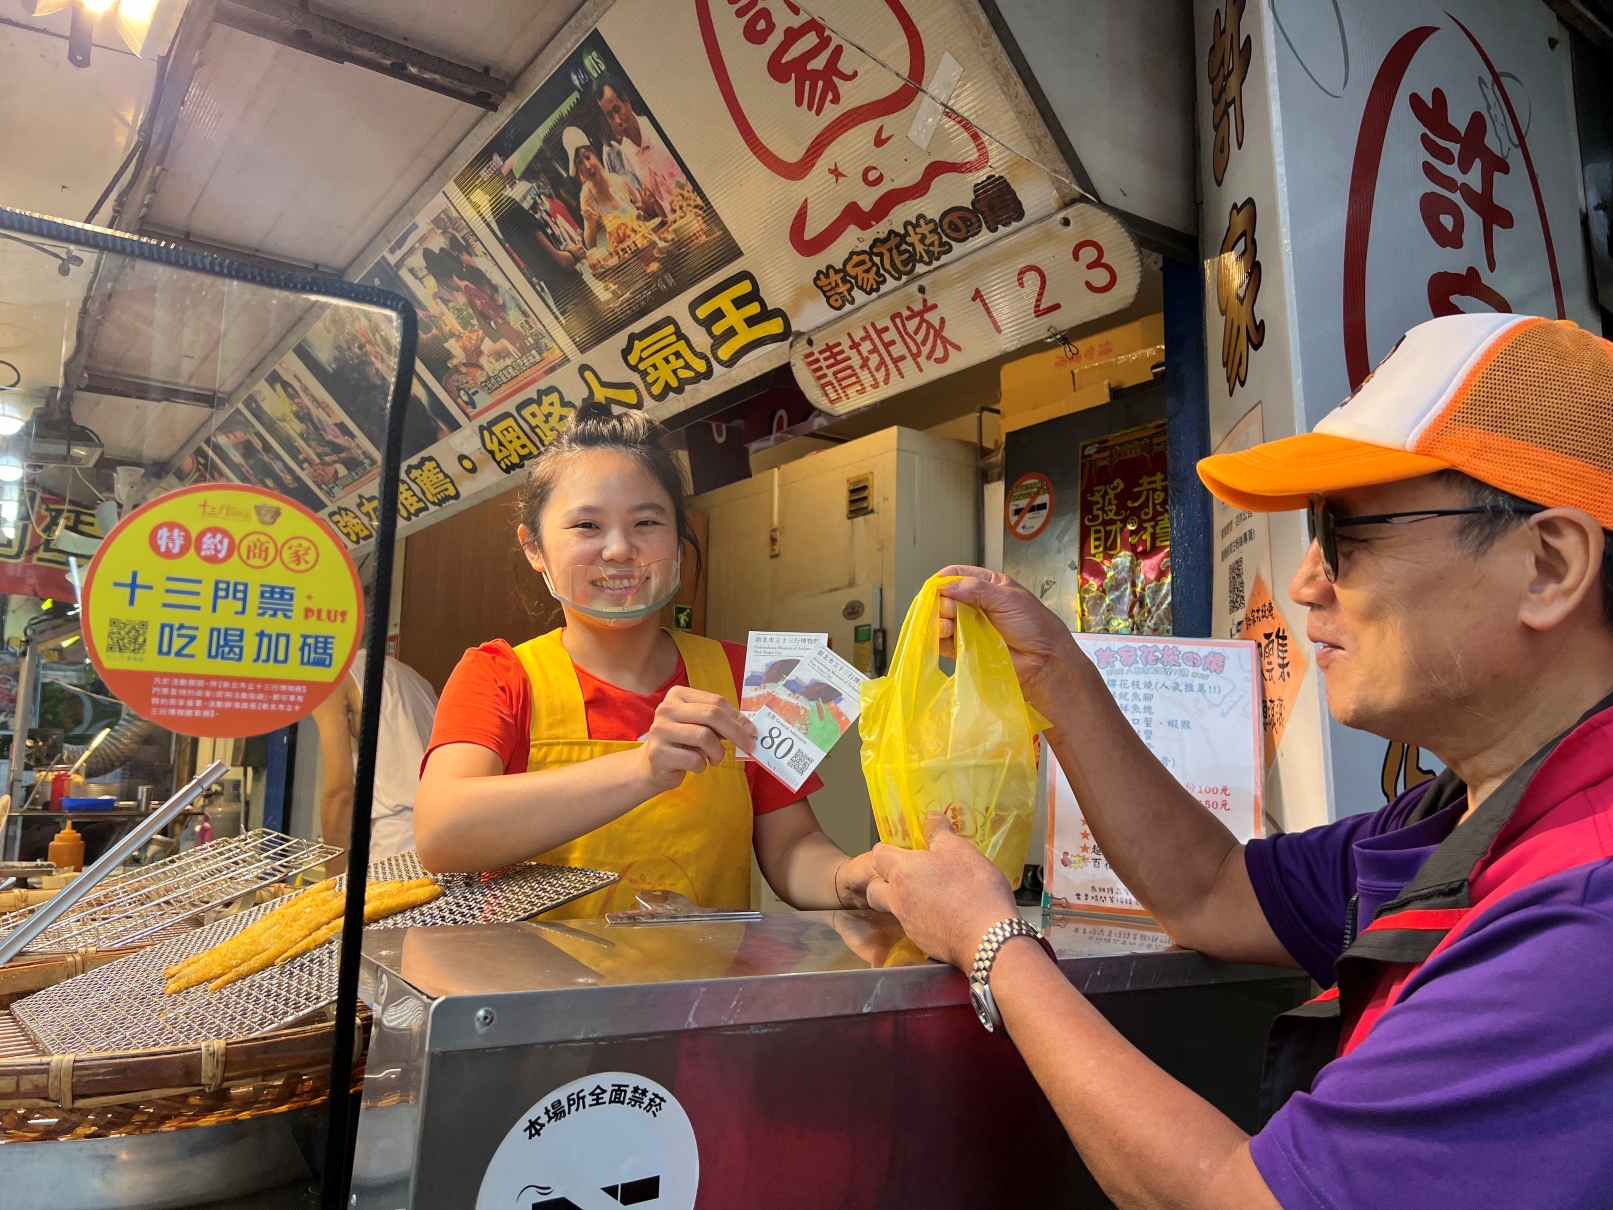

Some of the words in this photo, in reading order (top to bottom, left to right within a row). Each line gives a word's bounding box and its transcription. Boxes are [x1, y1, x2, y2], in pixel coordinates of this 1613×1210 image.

[804, 293, 962, 406] 請排隊
[971, 286, 1003, 335] 1
[1017, 264, 1062, 319] 2
[1071, 239, 1118, 293] 3
[157, 527, 310, 566] 特約商家
[112, 570, 296, 620] 十三門票
[303, 606, 348, 624] PLUS
[157, 622, 336, 669] 吃喝加碼
[1094, 645, 1226, 675] 許家花枝の燒
[760, 726, 794, 760] 80
[523, 1083, 667, 1140] 本場所全面禁菸
